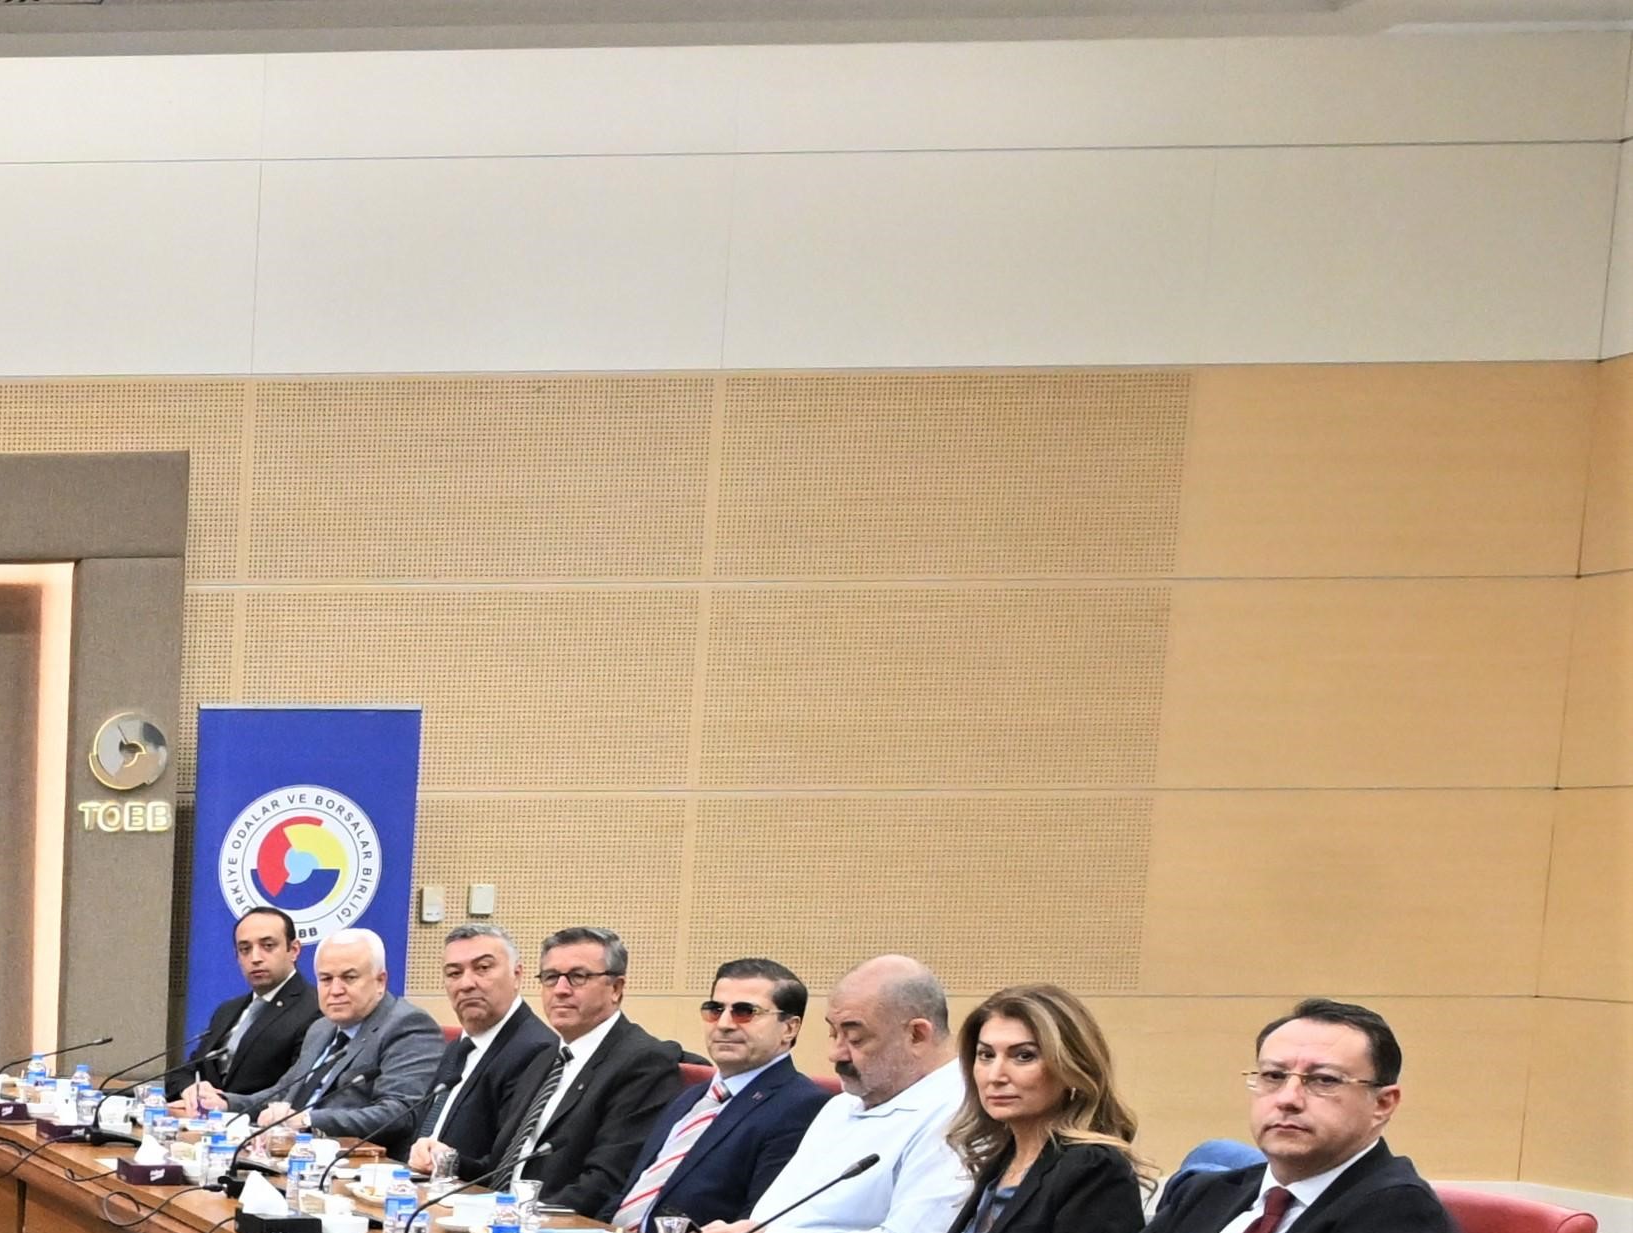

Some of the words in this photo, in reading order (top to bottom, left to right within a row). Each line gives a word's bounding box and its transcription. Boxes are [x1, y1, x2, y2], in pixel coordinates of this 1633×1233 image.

[77, 801, 173, 832] TOBB
[232, 799, 281, 850] ODALAR
[287, 793, 307, 804] VE
[315, 795, 373, 860] BORSALAR
[298, 927, 318, 938] BB
